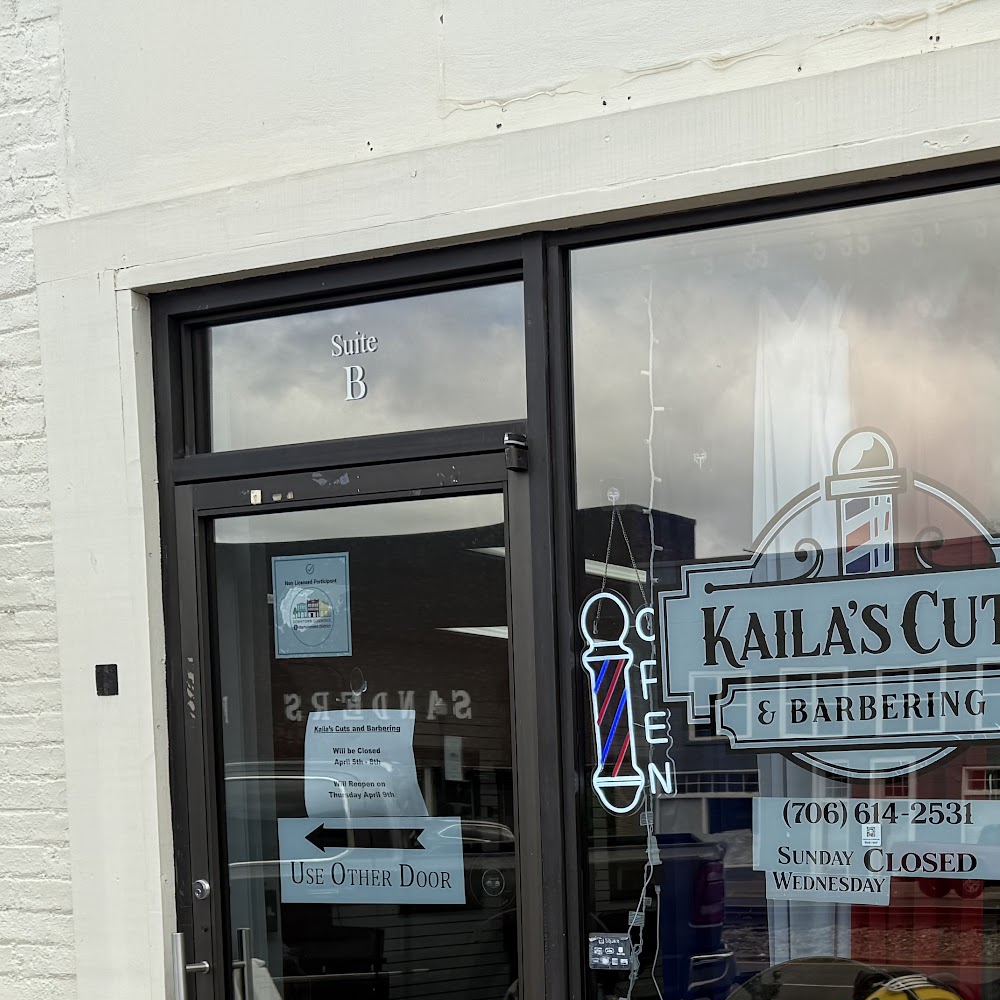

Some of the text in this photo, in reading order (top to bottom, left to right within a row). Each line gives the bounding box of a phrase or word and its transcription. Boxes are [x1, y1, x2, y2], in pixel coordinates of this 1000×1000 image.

[331, 331, 379, 357] Suite
[343, 365, 369, 402] B
[700, 599, 891, 669] KAILA'S
[756, 687, 988, 726] & BARBERING
[366, 724, 401, 733] Barbering
[334, 758, 351, 767] April
[328, 791, 362, 799] Thursday
[363, 791, 381, 799] April
[348, 780, 375, 789] Reopen
[781, 800, 975, 830] (706) 614-2531
[777, 845, 978, 874] SUNDAY CLOSED
[772, 871, 886, 894] WEDNESDAY
